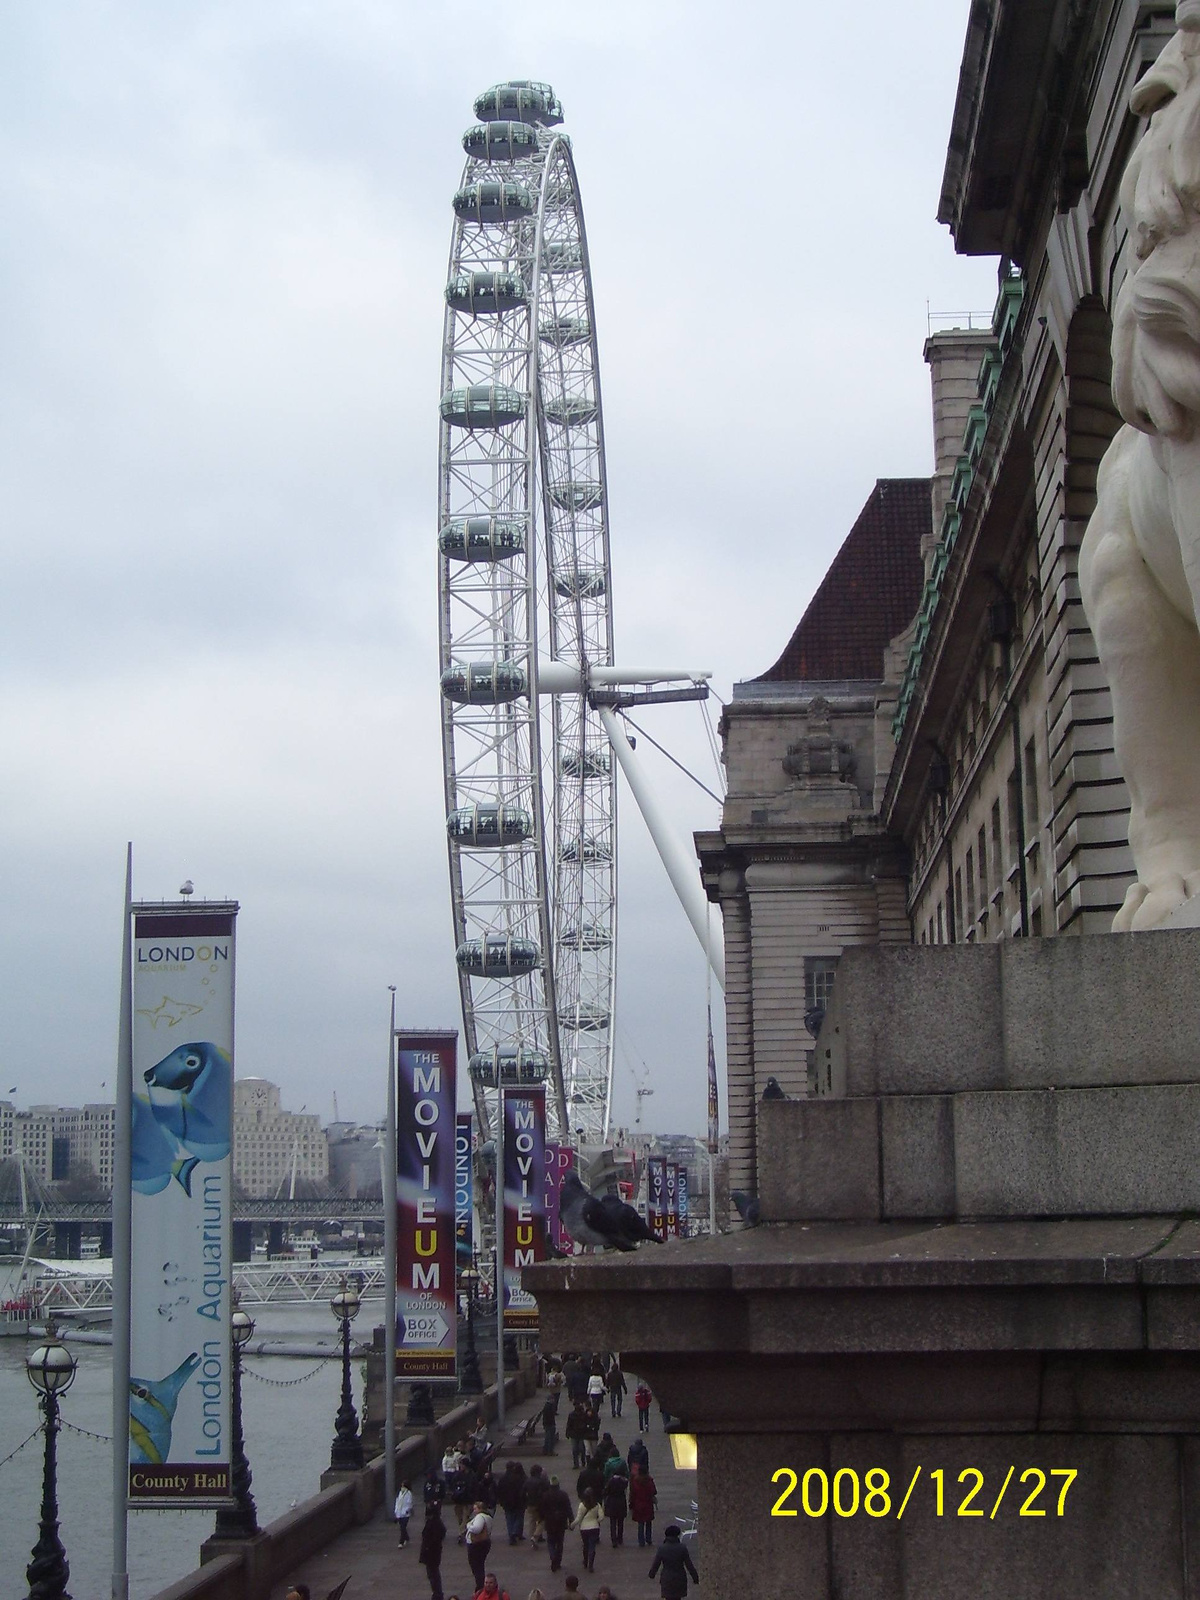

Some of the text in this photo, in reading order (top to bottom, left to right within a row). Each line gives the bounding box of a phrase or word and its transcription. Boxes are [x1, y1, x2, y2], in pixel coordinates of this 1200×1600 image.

[137, 945, 229, 963] LONDON
[138, 963, 187, 973] AQUARIUM
[413, 1053, 440, 1064] THE
[514, 1100, 534, 1109] THE
[412, 1067, 441, 1289] MOVIEUM
[514, 1110, 535, 1268] MOVIEUM
[653, 1166, 663, 1238] MOVIEUM
[666, 1170, 676, 1234] MOVIEUM
[419, 1292, 433, 1301] OF
[406, 1301, 447, 1310] LONDON
[195, 1175, 227, 1456] London Aquarium
[408, 1318, 437, 1331] BOX
[403, 1362, 448, 1372] County Hall
[131, 1472, 227, 1492] County Hall
